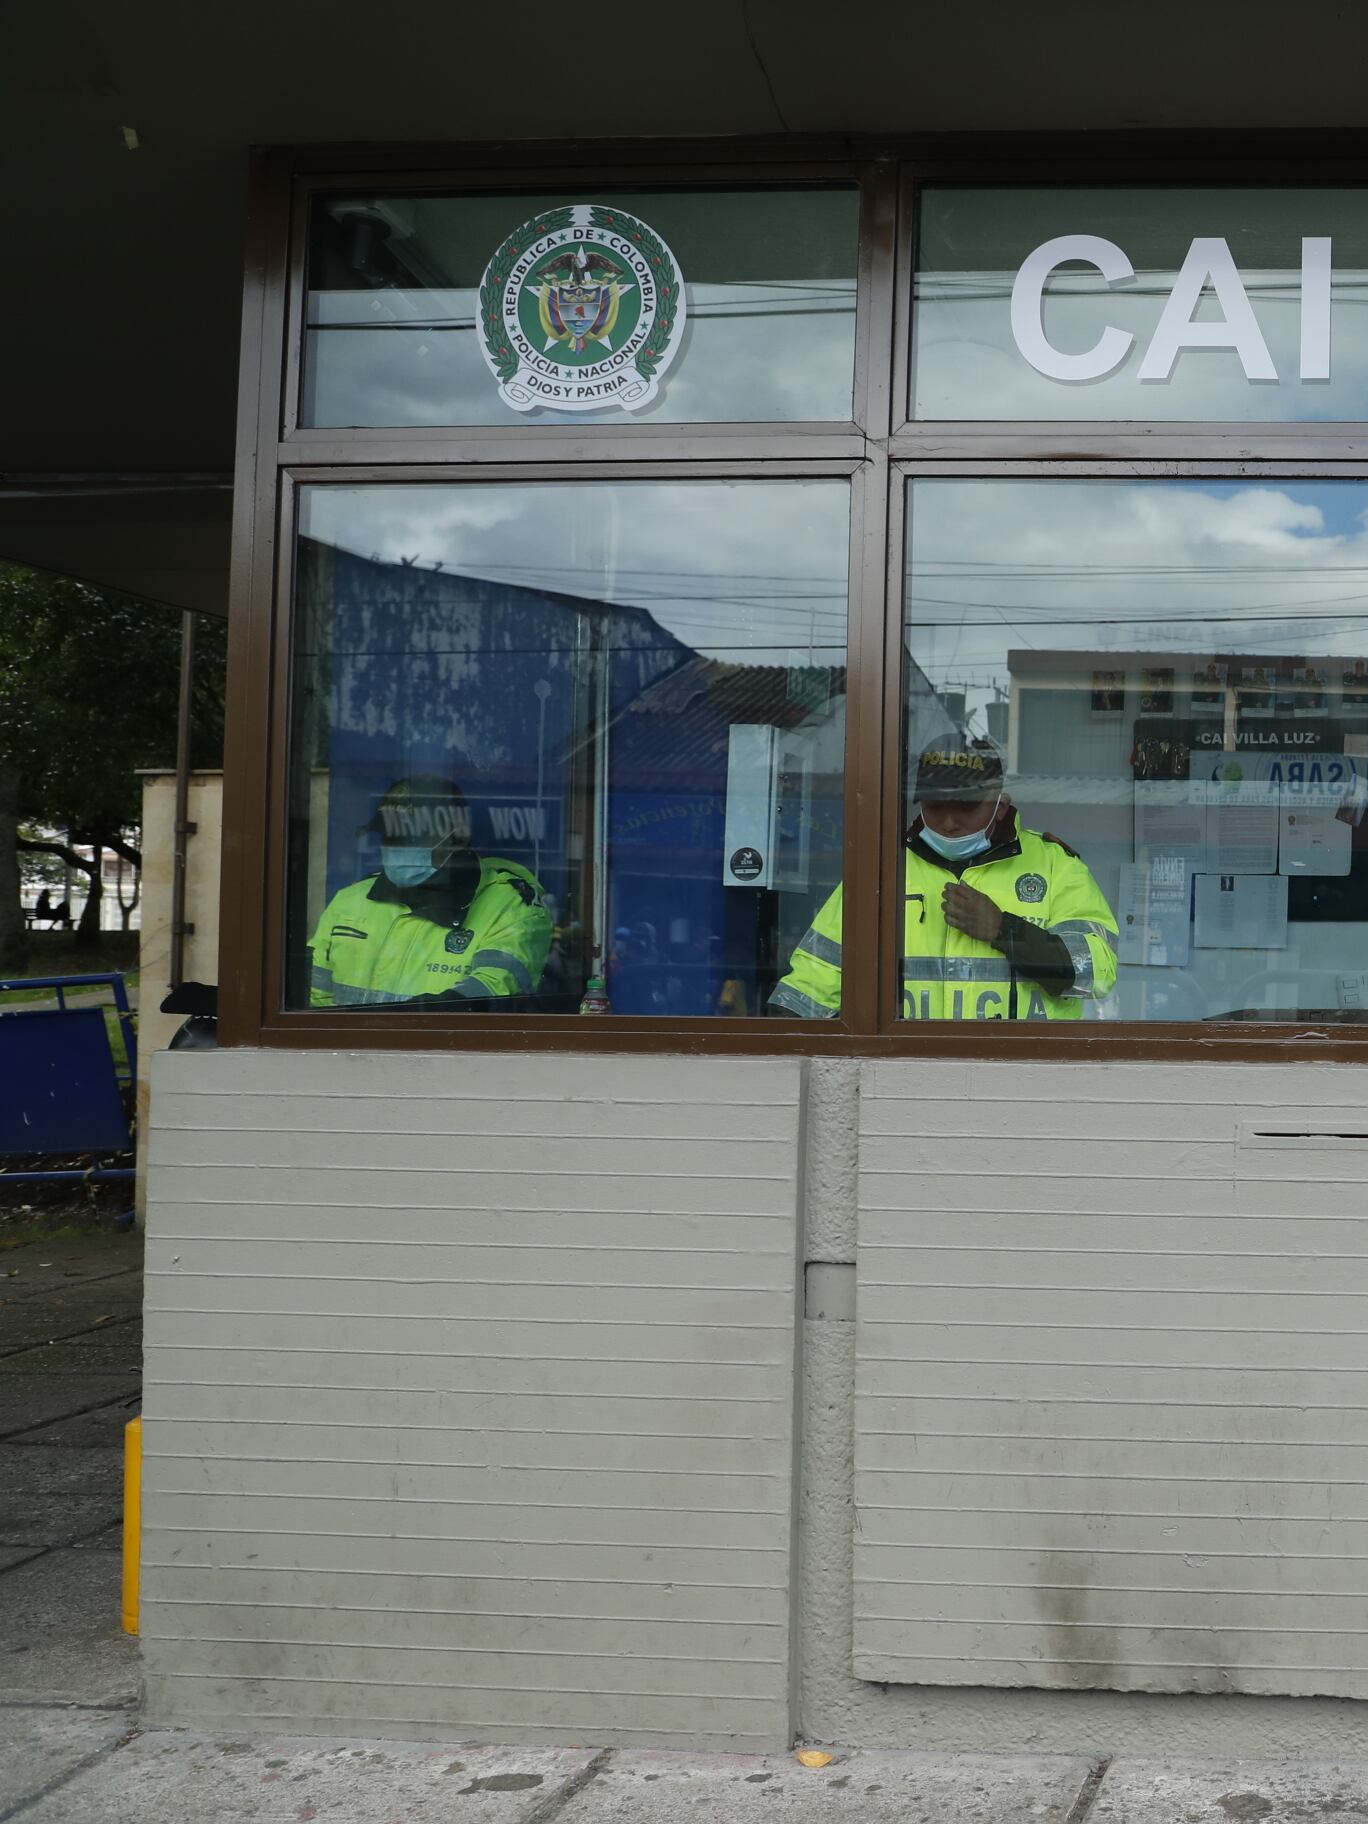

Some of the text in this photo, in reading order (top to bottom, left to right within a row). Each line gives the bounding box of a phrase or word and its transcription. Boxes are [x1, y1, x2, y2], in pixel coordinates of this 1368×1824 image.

[573, 229, 595, 240] DE
[609, 237, 654, 314] COLOMBIA
[1010, 234, 1332, 380] CAI
[578, 332, 646, 379] NACIONAL
[526, 375, 628, 397] DIOS Y PATRIA
[1232, 732, 1279, 745] VILLA
[1283, 732, 1316, 745] LUZ
[921, 750, 985, 772] POLICIA
